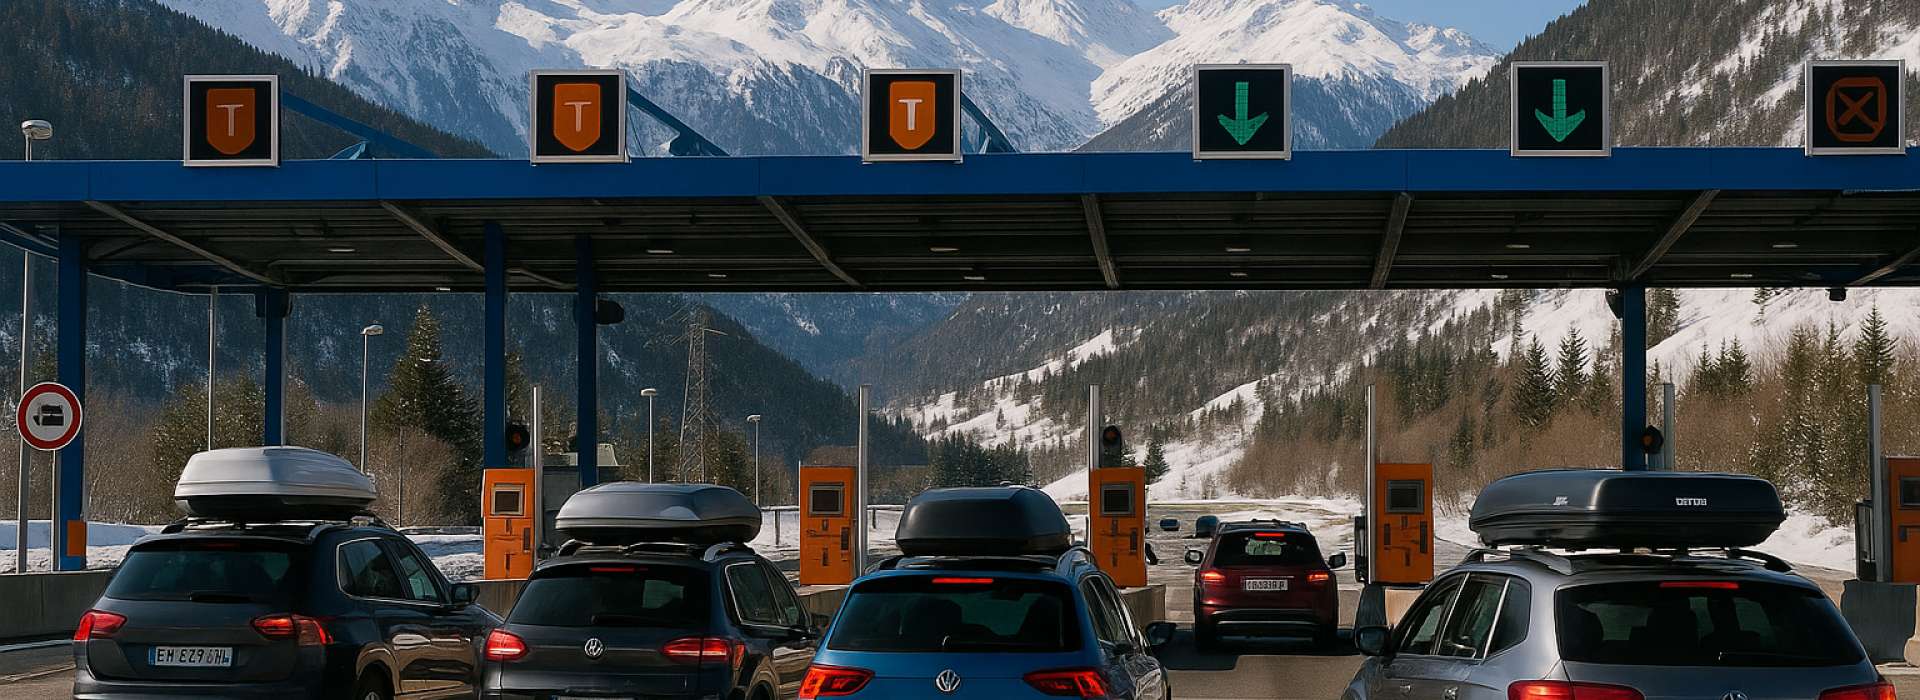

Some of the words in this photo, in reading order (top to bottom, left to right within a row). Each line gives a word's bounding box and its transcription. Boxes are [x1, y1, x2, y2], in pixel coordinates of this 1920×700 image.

[216, 104, 244, 136] T
[563, 102, 592, 132] T
[898, 98, 923, 131] T
